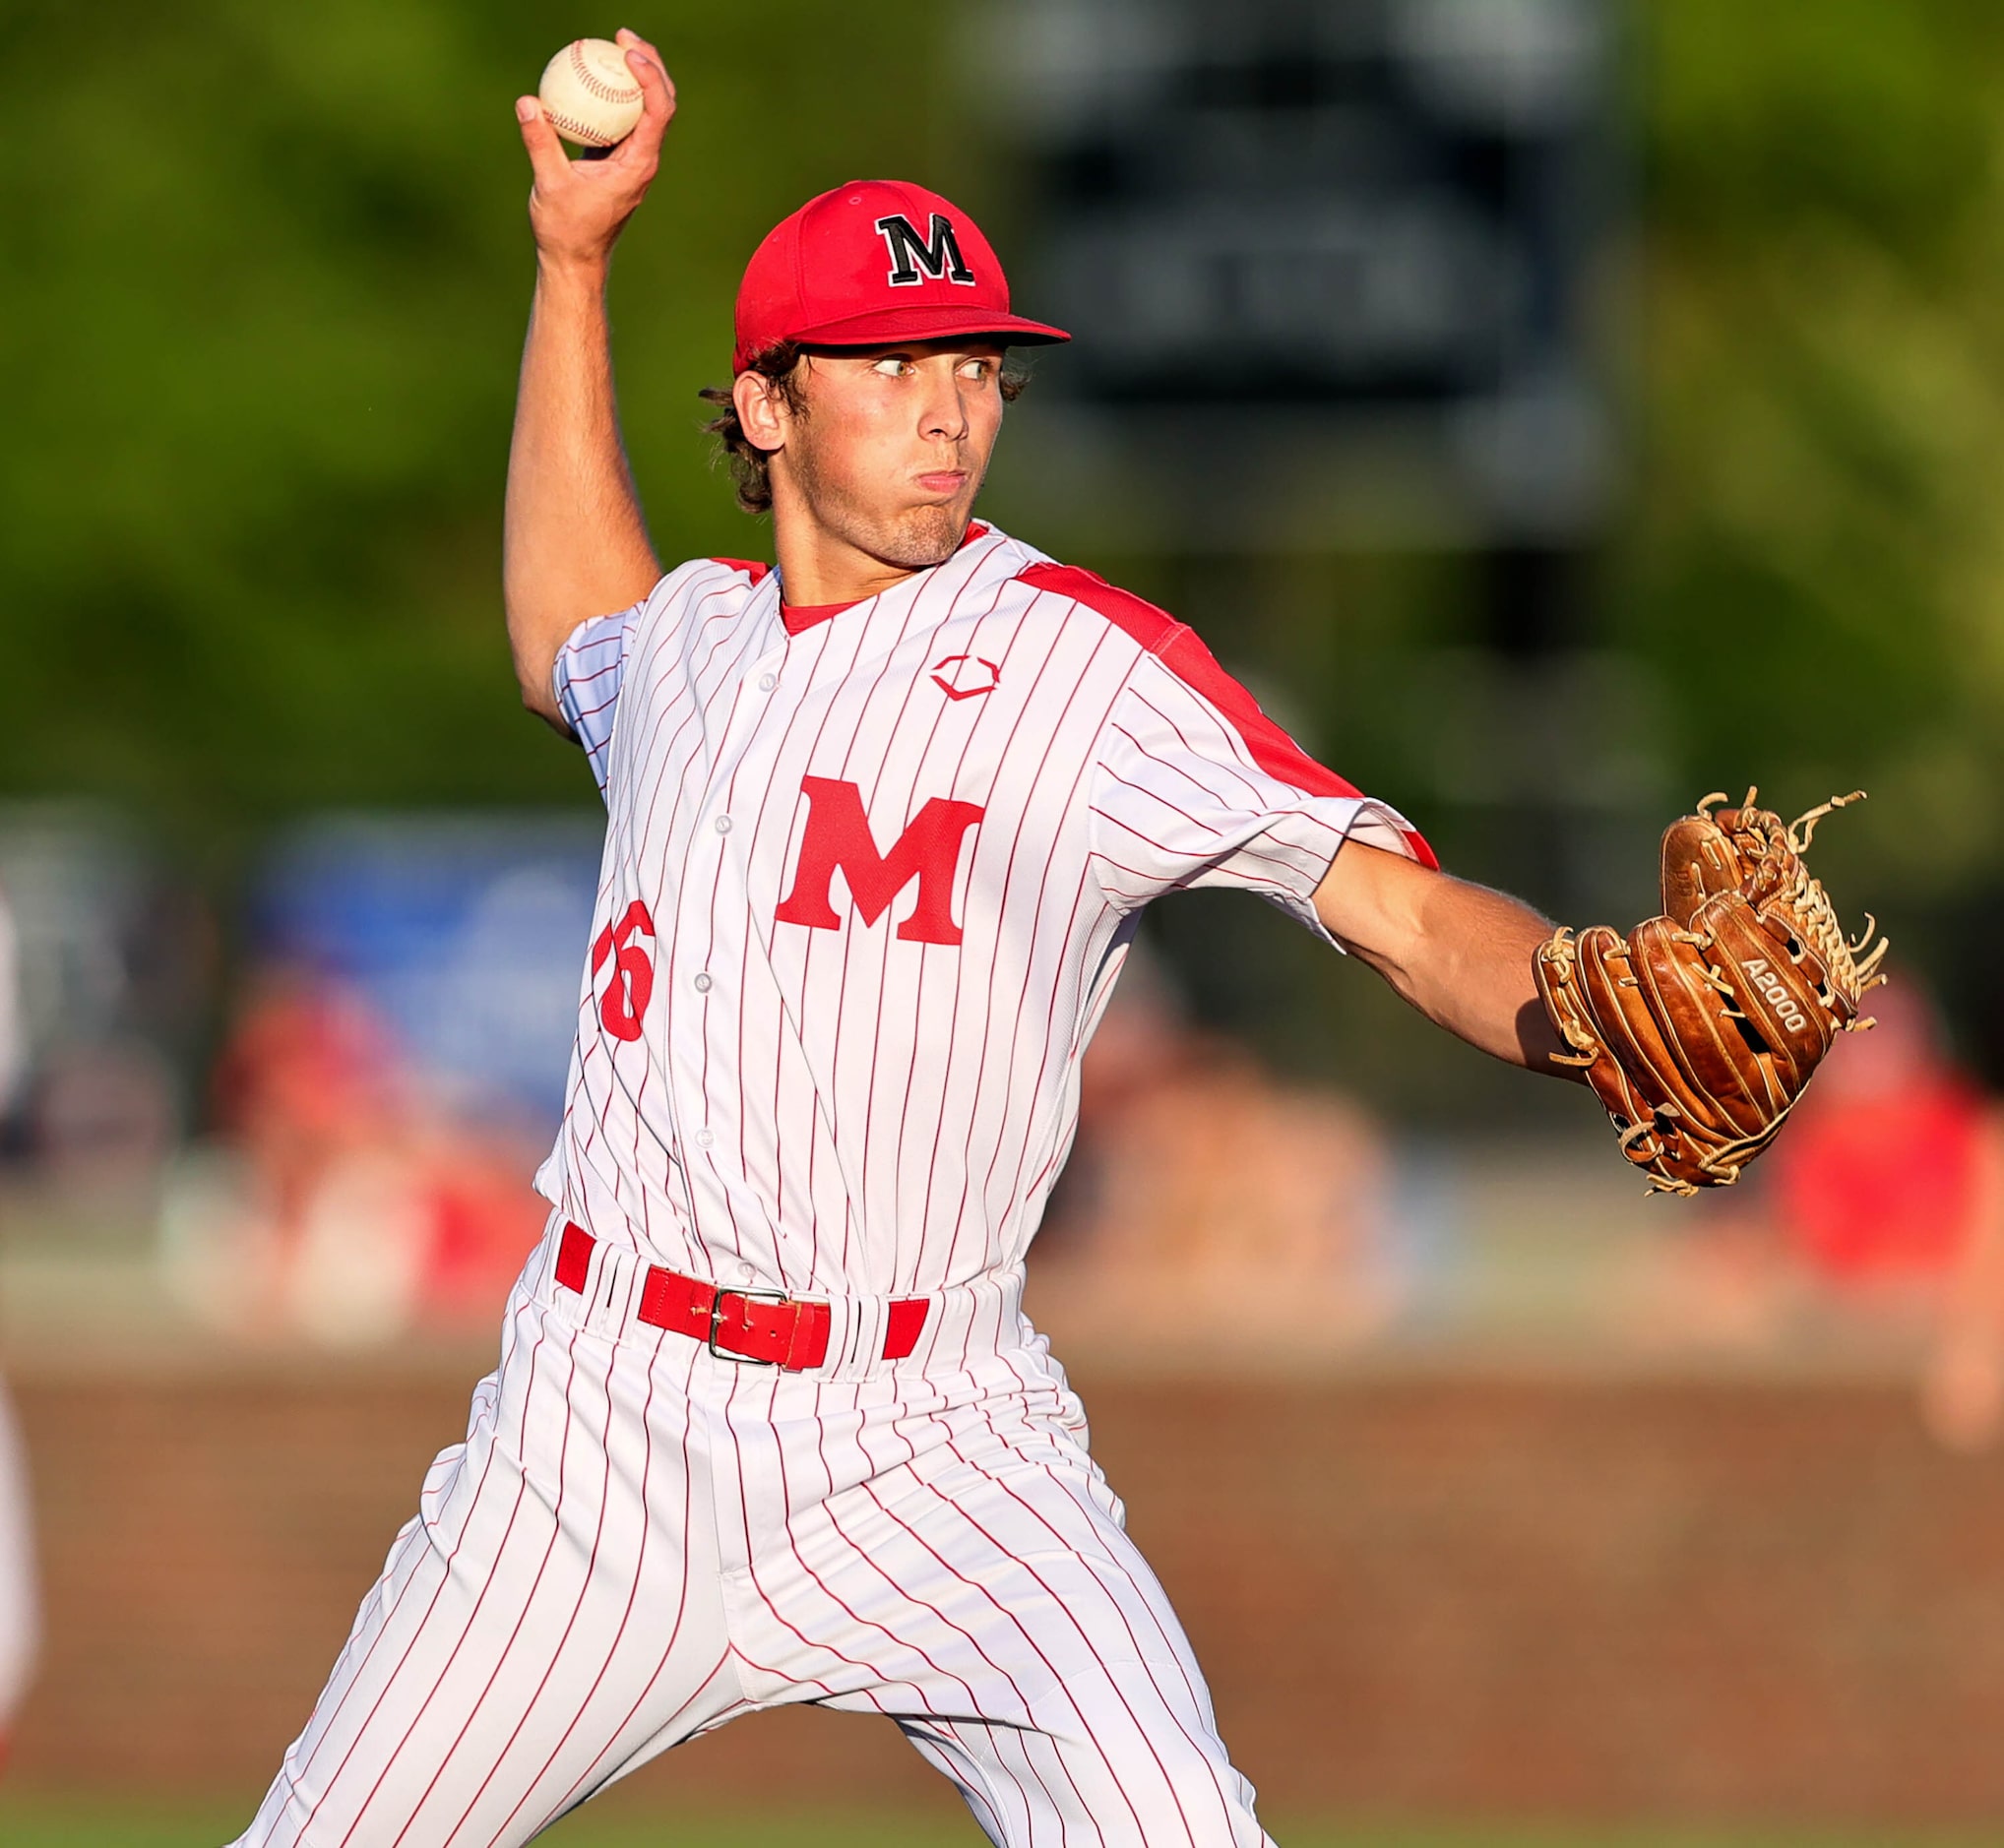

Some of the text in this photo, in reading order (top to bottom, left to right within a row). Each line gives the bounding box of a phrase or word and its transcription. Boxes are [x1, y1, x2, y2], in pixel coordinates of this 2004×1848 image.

[874, 213, 976, 287] M
[775, 775, 984, 946] M
[1740, 958, 1807, 1033] A2000
